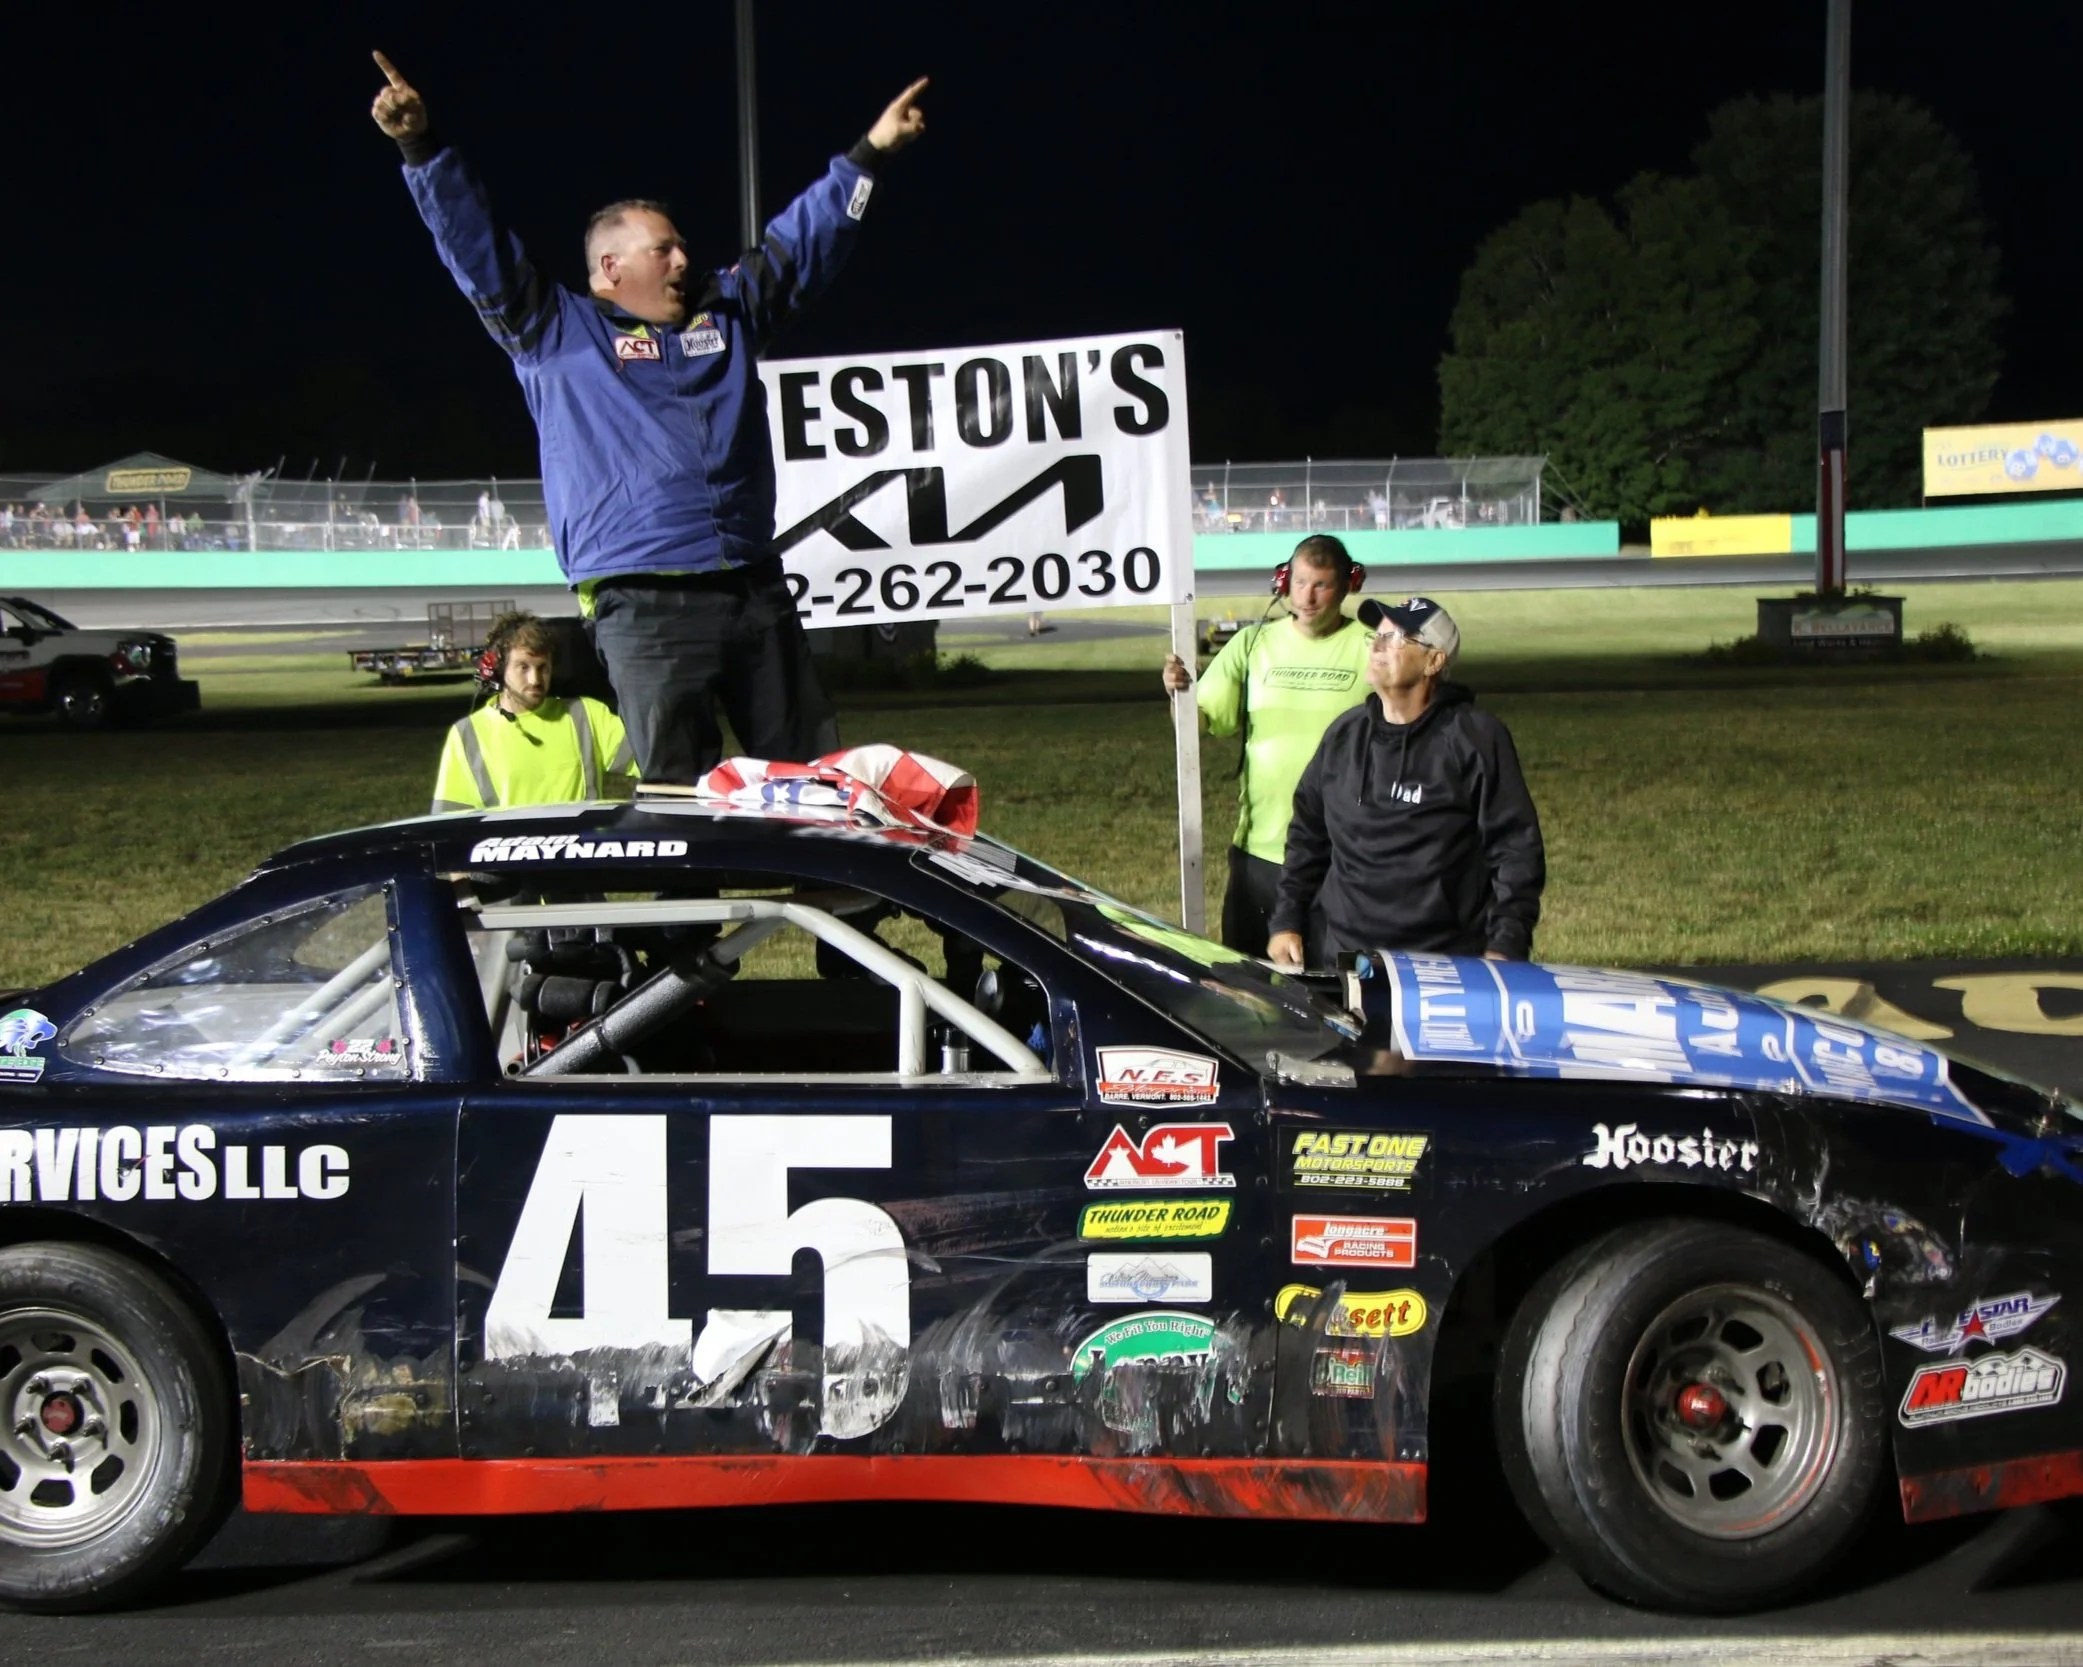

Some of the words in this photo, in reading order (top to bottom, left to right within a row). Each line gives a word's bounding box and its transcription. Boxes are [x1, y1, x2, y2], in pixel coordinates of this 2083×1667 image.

[620, 340, 656, 355] ACT
[761, 343, 1169, 461] ESTON'S
[1938, 448, 2009, 467] LOTTERY
[1271, 670, 1318, 681] THUNDER
[1320, 671, 1350, 682] ROAD
[470, 840, 688, 863] MAYNARD
[1087, 1126, 1231, 1177] ACT
[1292, 1132, 1369, 1155] FAST
[1368, 1134, 1428, 1159] ONE
[1582, 1122, 1759, 1172] Hoosier
[0, 1124, 217, 1202] RVICES
[225, 1144, 350, 1200] LLC
[1293, 1155, 1418, 1173] MOTORSPORTS
[1089, 1207, 1169, 1224] THUNDER
[1171, 1206, 1221, 1222] ROAD
[1324, 1221, 1385, 1238] Longacre
[1334, 1249, 1394, 1258] PRODUCTS
[1343, 1241, 1385, 1250] RACING
[484, 1113, 911, 1440] 45
[1122, 1324, 1143, 1339] Fit
[1144, 1320, 1167, 1332] You
